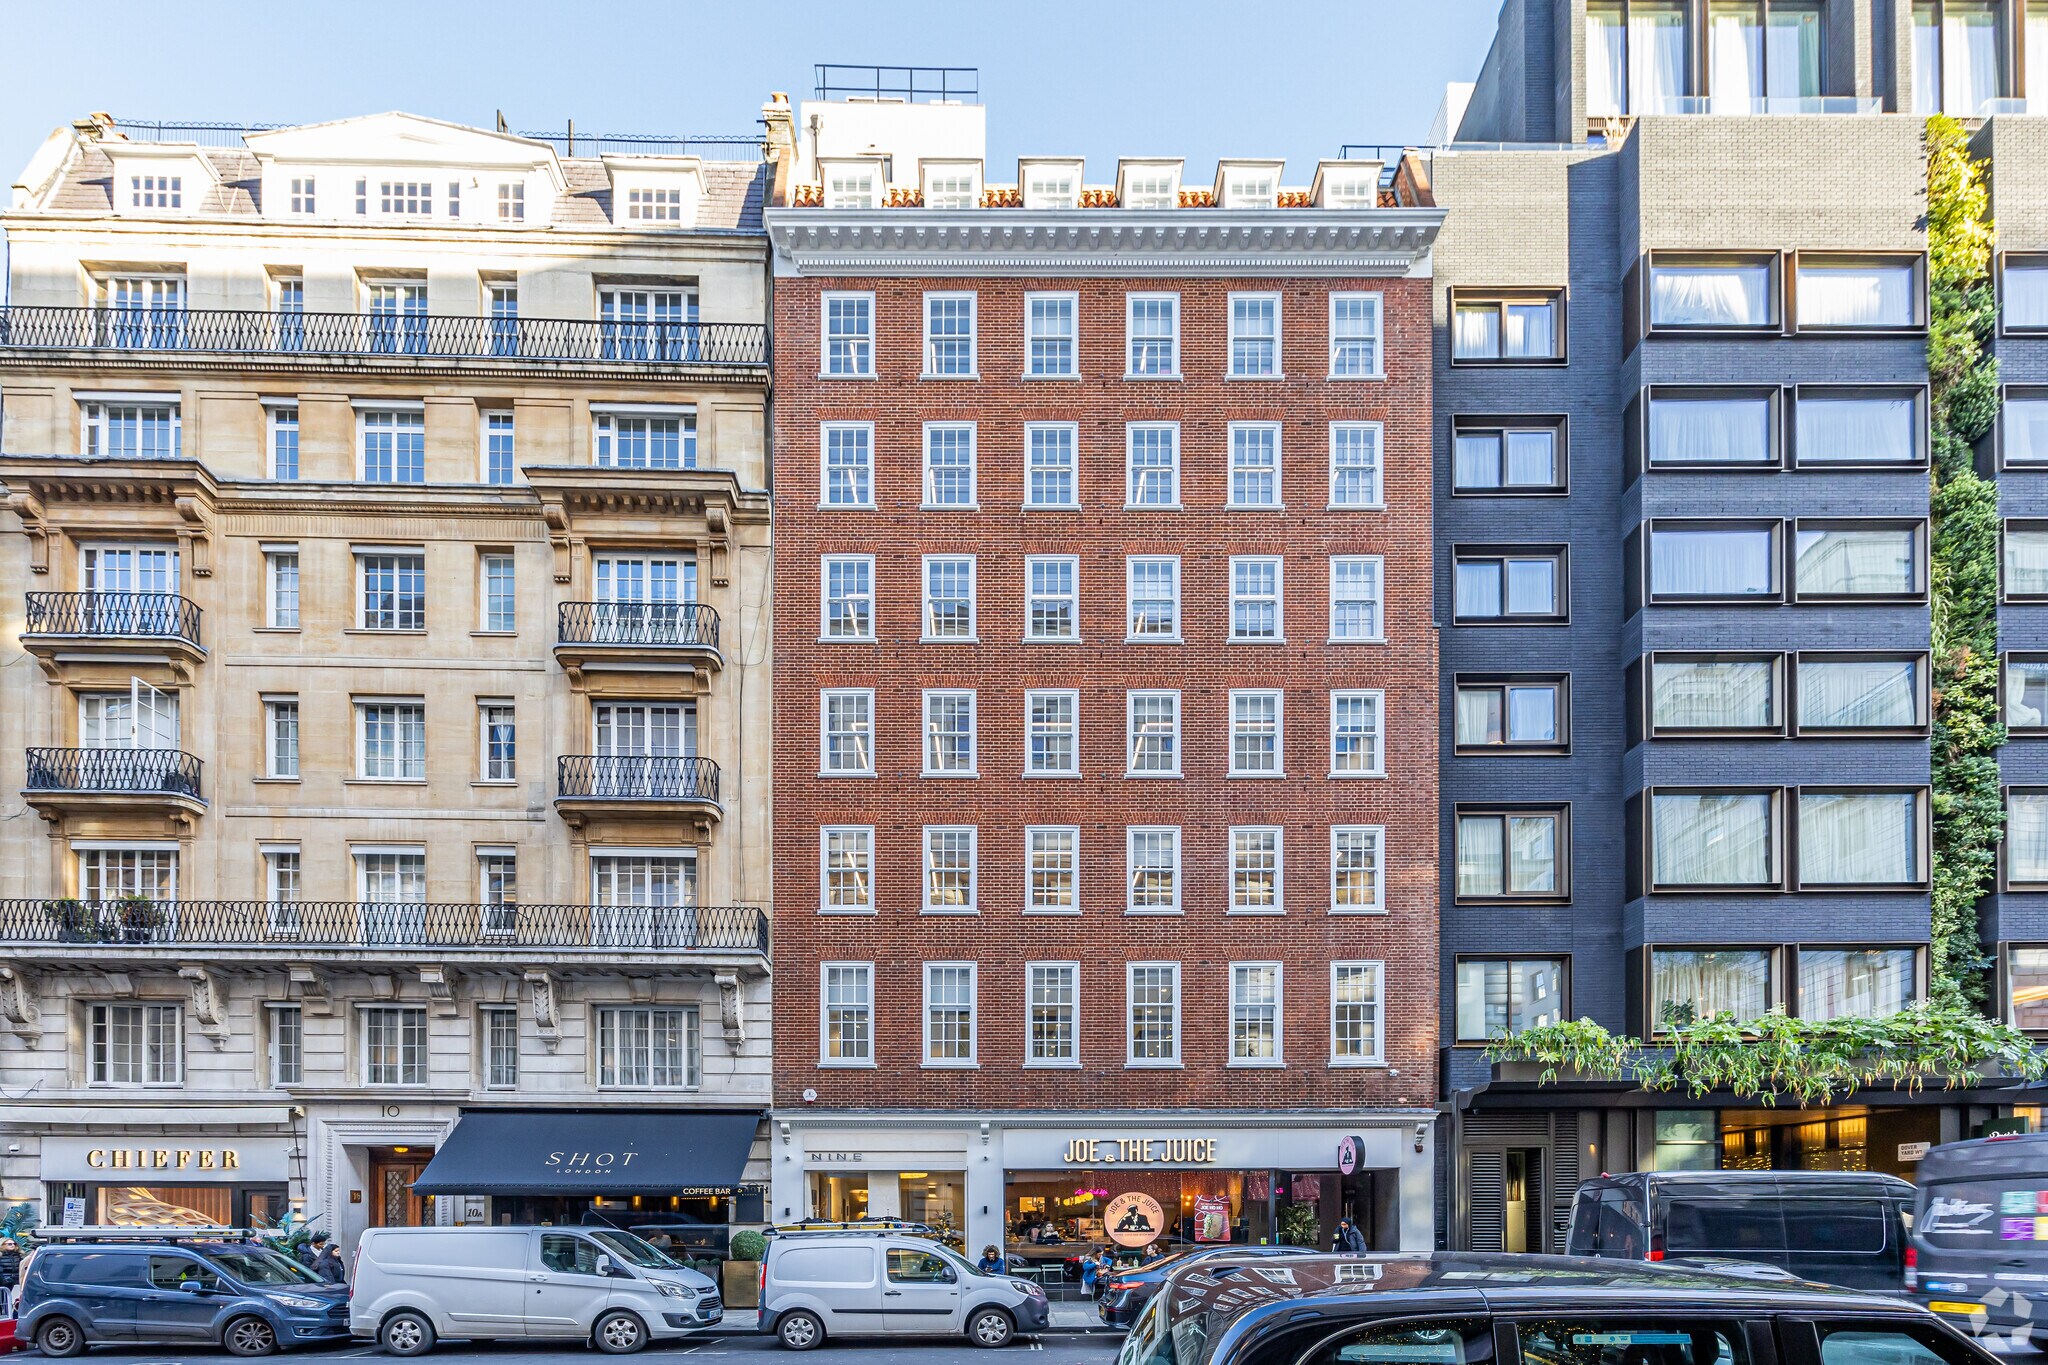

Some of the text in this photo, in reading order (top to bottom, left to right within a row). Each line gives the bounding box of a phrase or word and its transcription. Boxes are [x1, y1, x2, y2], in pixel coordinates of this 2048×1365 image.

[381, 1105, 400, 1118] 10
[811, 1153, 863, 1161] NINE
[1065, 1138, 1218, 1162] JOE & THE JUICE
[86, 1149, 239, 1168] CHIEFER
[544, 1151, 639, 1166] SHOT
[682, 1187, 731, 1195] COFFEE BAR
[1109, 1202, 1121, 1215] JOE
[1127, 1195, 1142, 1203] THE
[1141, 1198, 1160, 1215] JUICE
